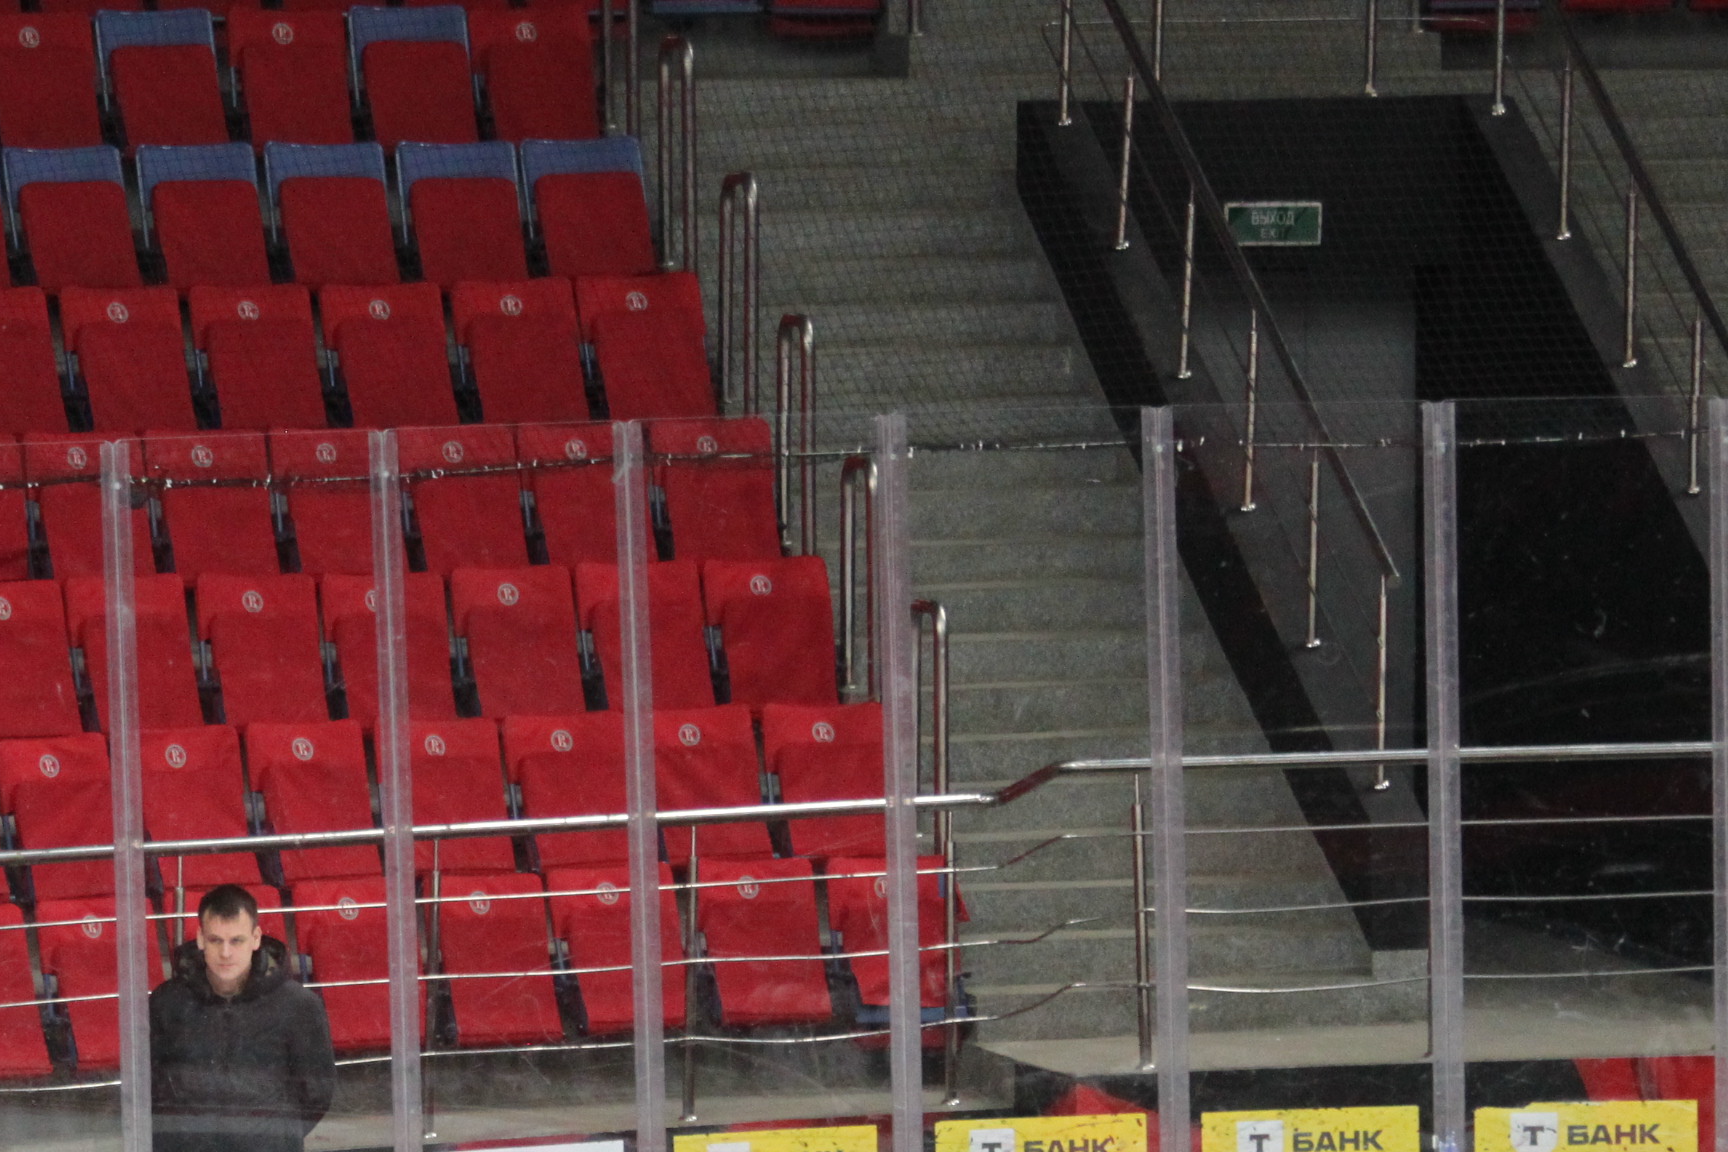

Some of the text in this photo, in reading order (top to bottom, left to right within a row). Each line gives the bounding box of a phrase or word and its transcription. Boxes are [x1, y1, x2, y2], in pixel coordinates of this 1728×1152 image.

[1251, 210, 1295, 226] ВЫХОД
[1292, 1130, 1384, 1152] БАНК
[1567, 1123, 1661, 1146] БАНК
